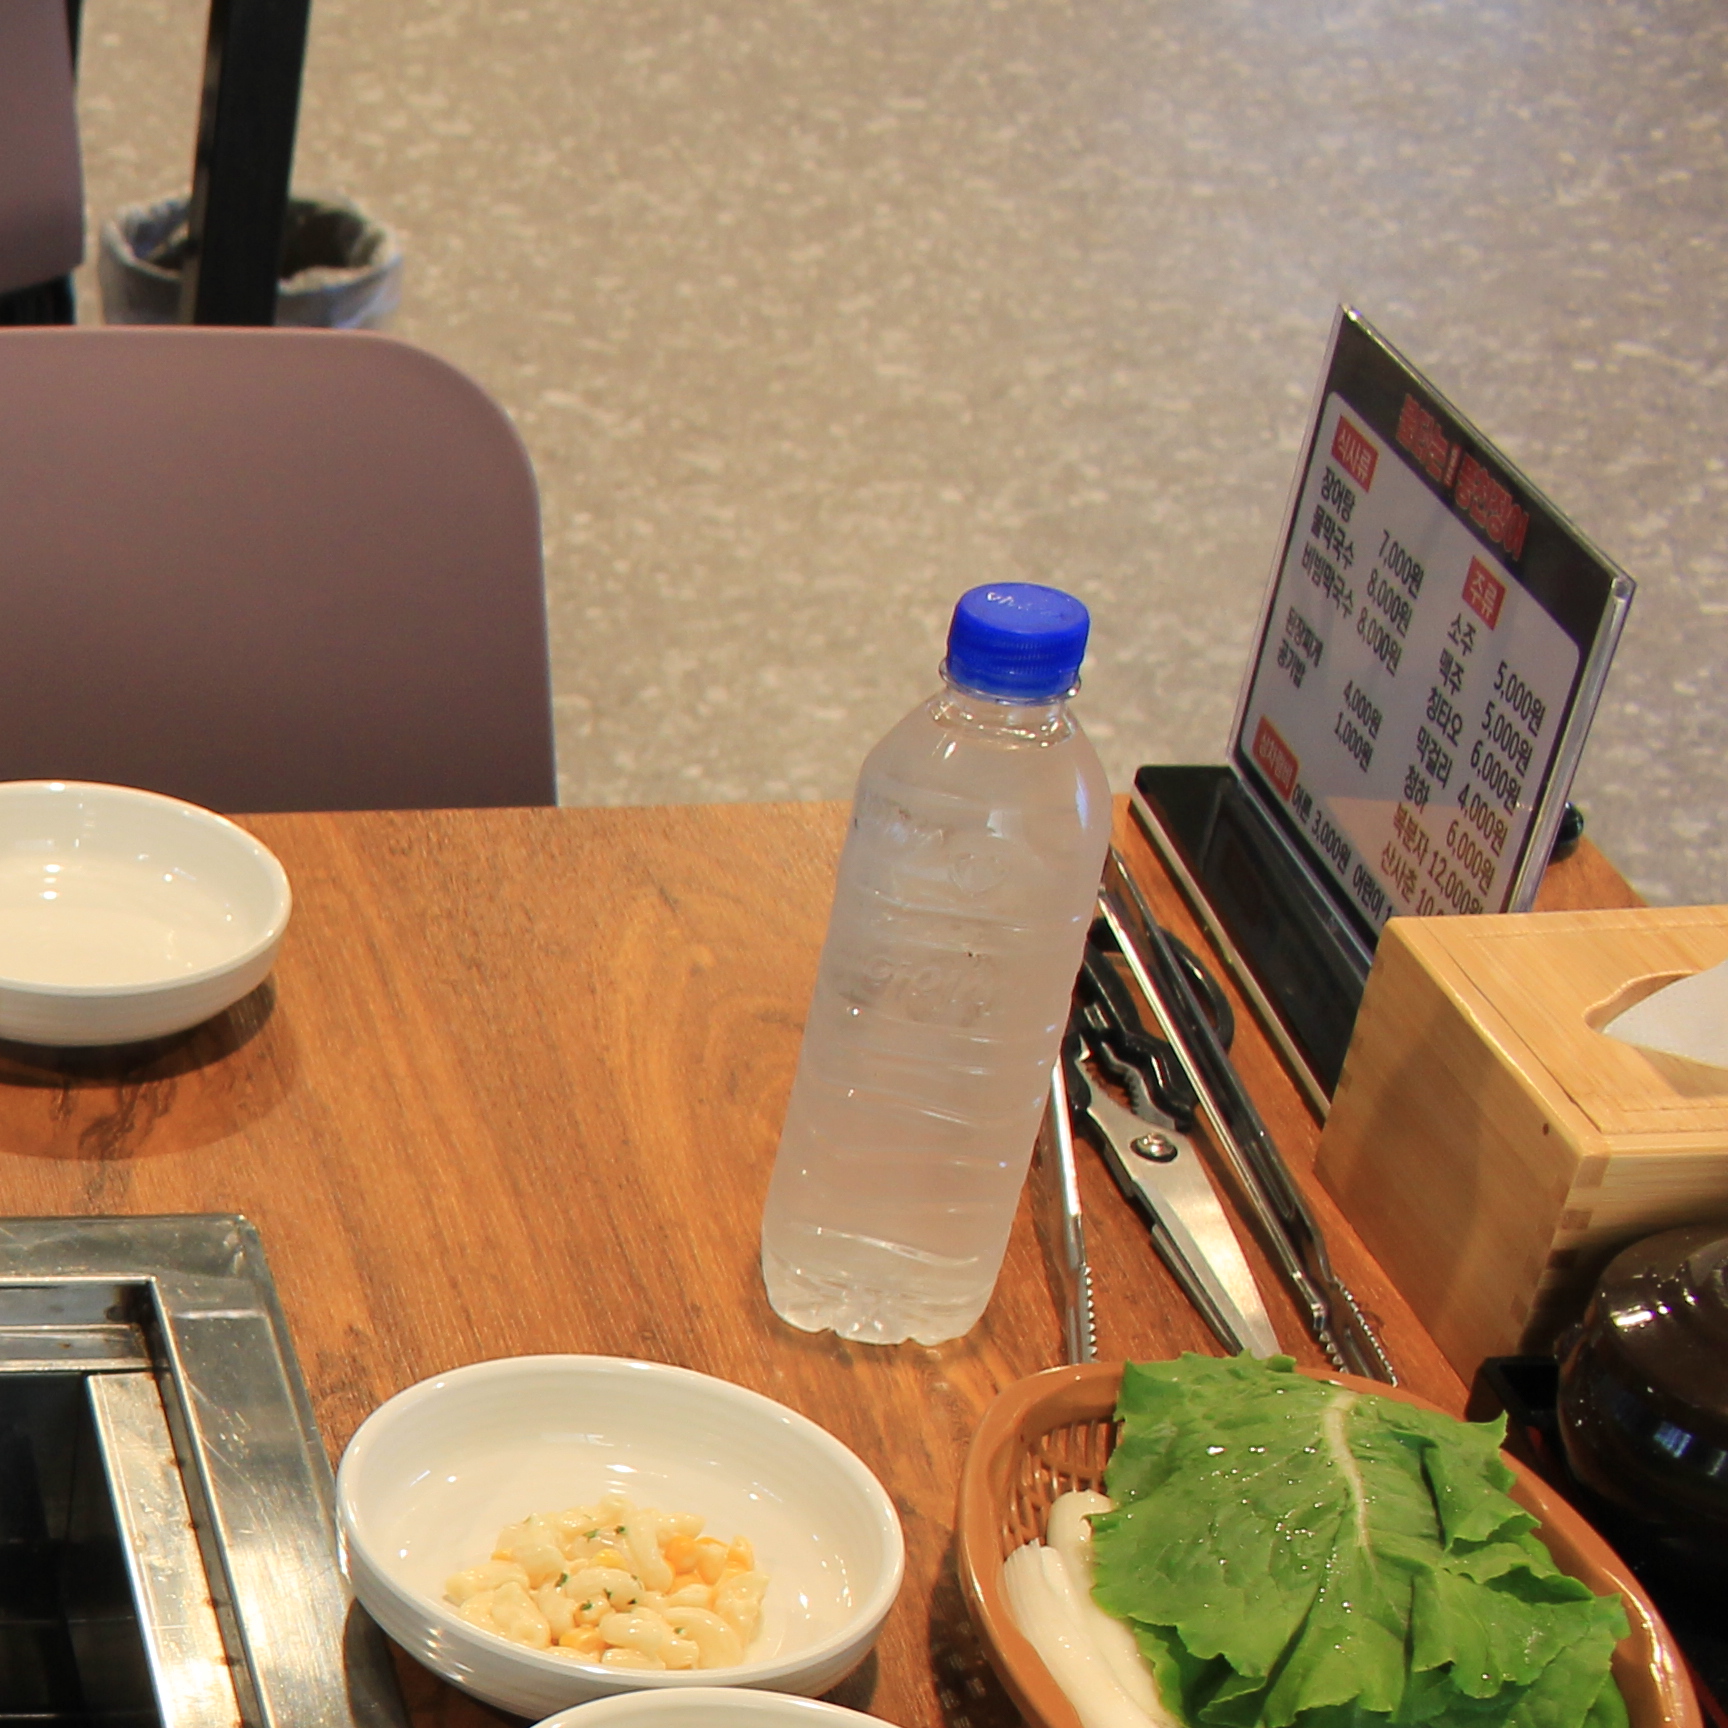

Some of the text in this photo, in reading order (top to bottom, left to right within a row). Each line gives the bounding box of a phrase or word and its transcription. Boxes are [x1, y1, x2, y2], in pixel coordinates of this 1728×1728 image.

[1337, 428, 1373, 481] 식사류
[1310, 504, 1413, 638] 물막국수 8,000원
[1320, 466, 1424, 600] 장어탕 7,000원
[1470, 570, 1498, 618] 주류
[1301, 541, 1403, 677] 비빔막국수 8,000원
[1277, 638, 1375, 774] 공기밥 1,000원
[1344, 679, 1383, 740] 4,000원
[1426, 686, 1464, 748] 칭타오
[1439, 648, 1533, 778] 맥주 5,000원
[1448, 613, 1546, 738] 소주 5,000원
[1291, 783, 1313, 825] 어른
[1353, 863, 1385, 921] 어린이
[1393, 802, 1429, 866] 복분자
[1404, 764, 1496, 897] 청하 6,000원
[1416, 725, 1509, 857] 막걸리 4,000원
[1380, 840, 1418, 903] 산사춘
